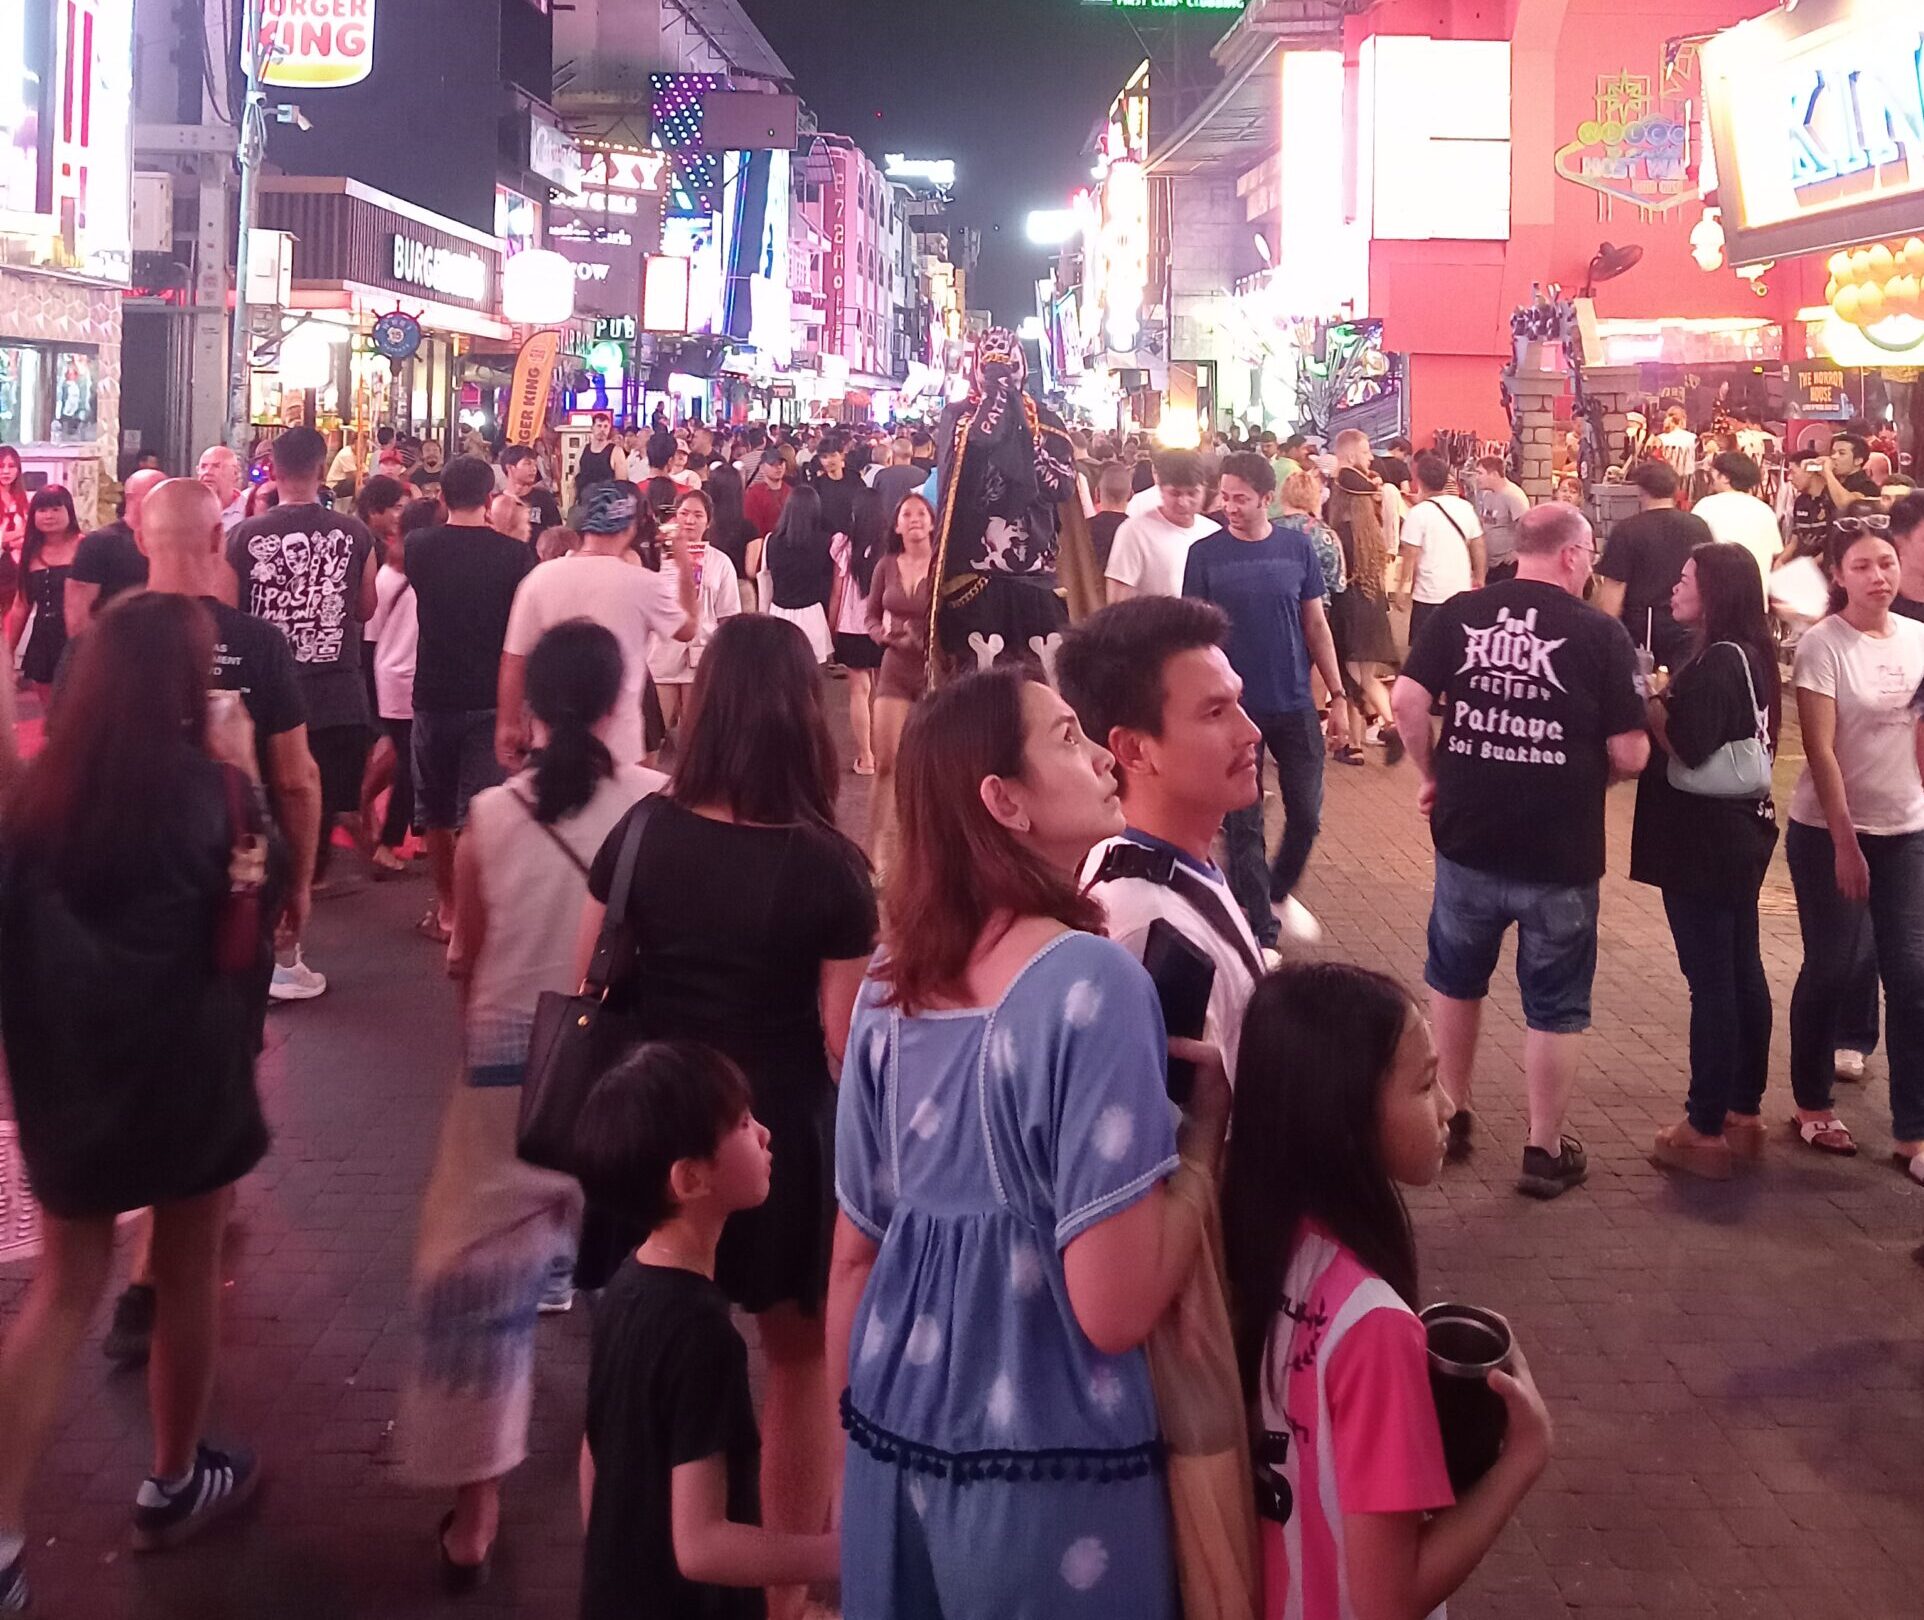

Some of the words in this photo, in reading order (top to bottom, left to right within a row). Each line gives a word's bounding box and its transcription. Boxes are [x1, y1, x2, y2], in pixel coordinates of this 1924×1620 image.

[595, 315, 636, 339] PUB
[523, 366, 541, 407] KING
[518, 409, 534, 445] GER
[1454, 622, 1569, 694] ROCK
[1454, 701, 1565, 743] Pattaya
[1449, 736, 1474, 756] Soi
[1480, 741, 1567, 765] Buakhao
